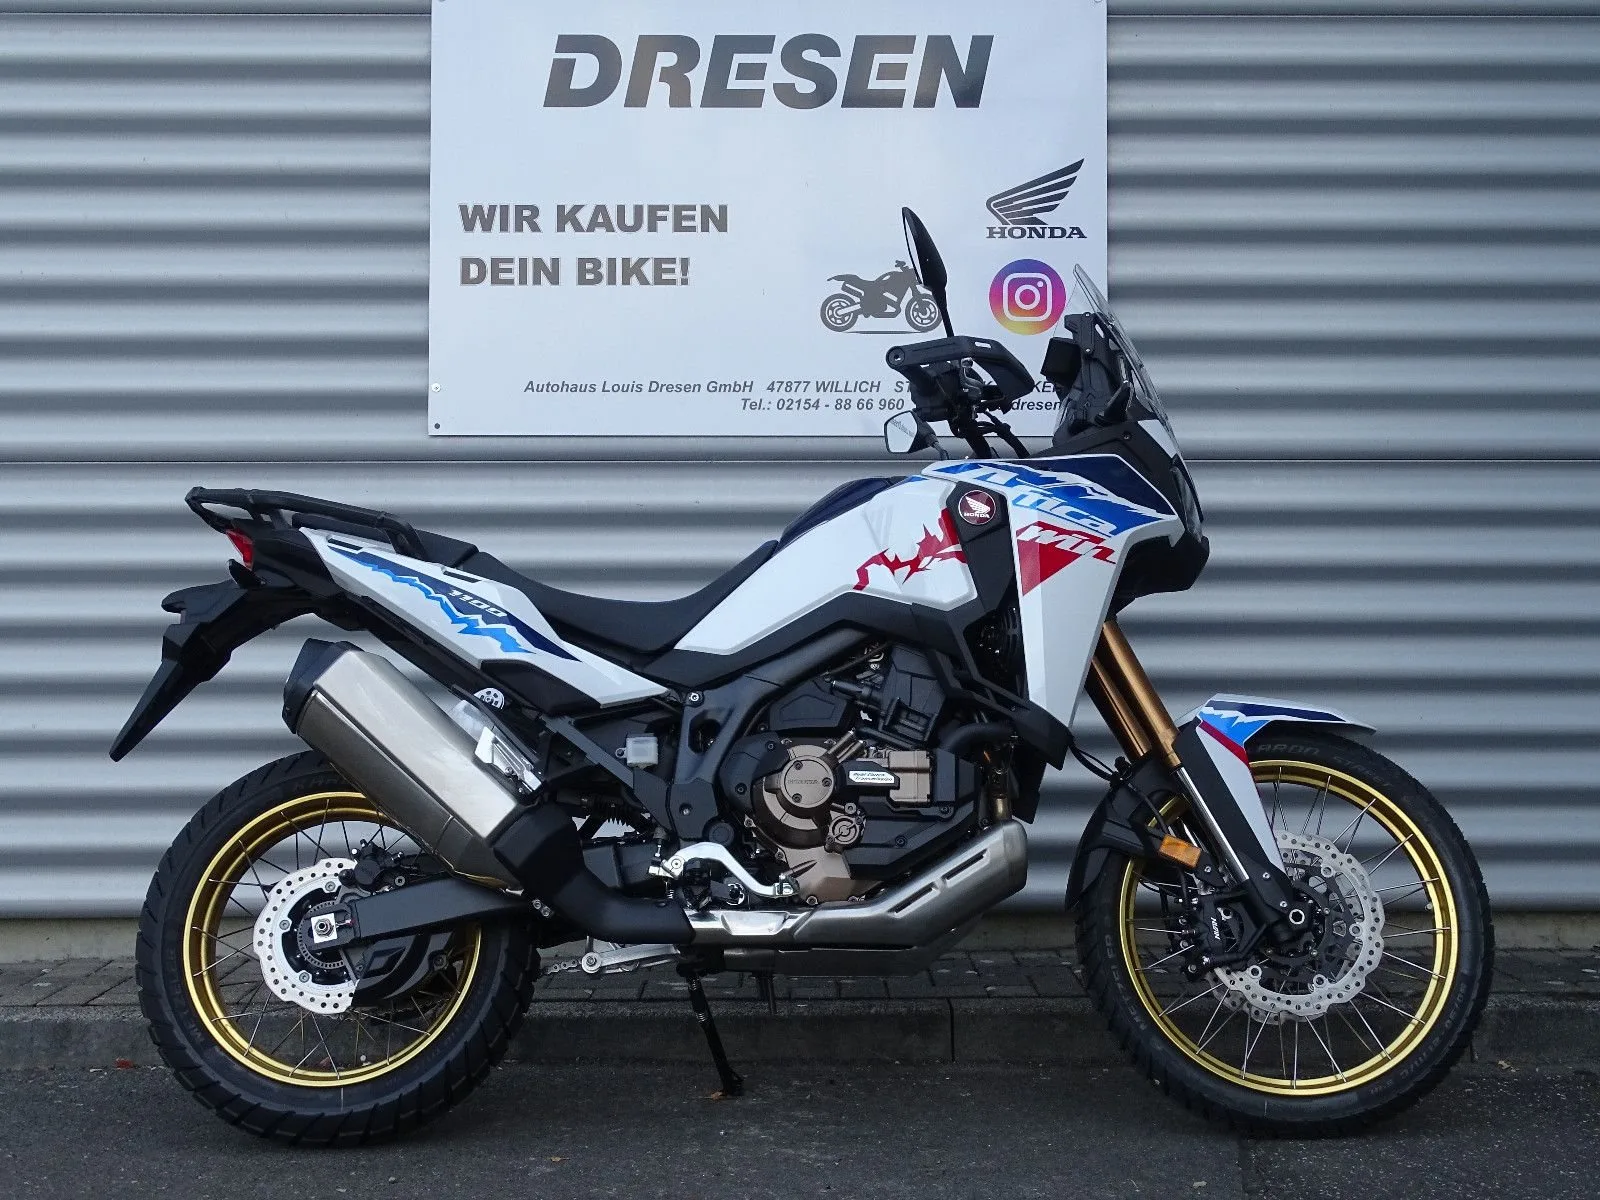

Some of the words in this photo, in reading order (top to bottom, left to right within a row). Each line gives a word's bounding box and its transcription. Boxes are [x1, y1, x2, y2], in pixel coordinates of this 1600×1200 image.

[543, 33, 994, 109] DRESEN
[458, 203, 542, 233] WIR
[556, 203, 728, 233] KAUFEN
[986, 226, 1087, 239] HONDA
[460, 256, 560, 286] DEIN
[576, 256, 690, 286] BIKE!
[524, 380, 597, 393] Autohaus
[601, 380, 643, 393] Louis
[648, 380, 701, 393] Dresen
[706, 380, 753, 393] GmbH
[766, 380, 811, 393] 47877
[815, 380, 881, 393] WILLICH
[741, 398, 771, 411] Tel.:
[776, 398, 820, 411] 02154
[835, 398, 851, 411] 88
[856, 398, 874, 411] 66
[878, 398, 905, 411] 960
[449, 589, 507, 617] 1100
